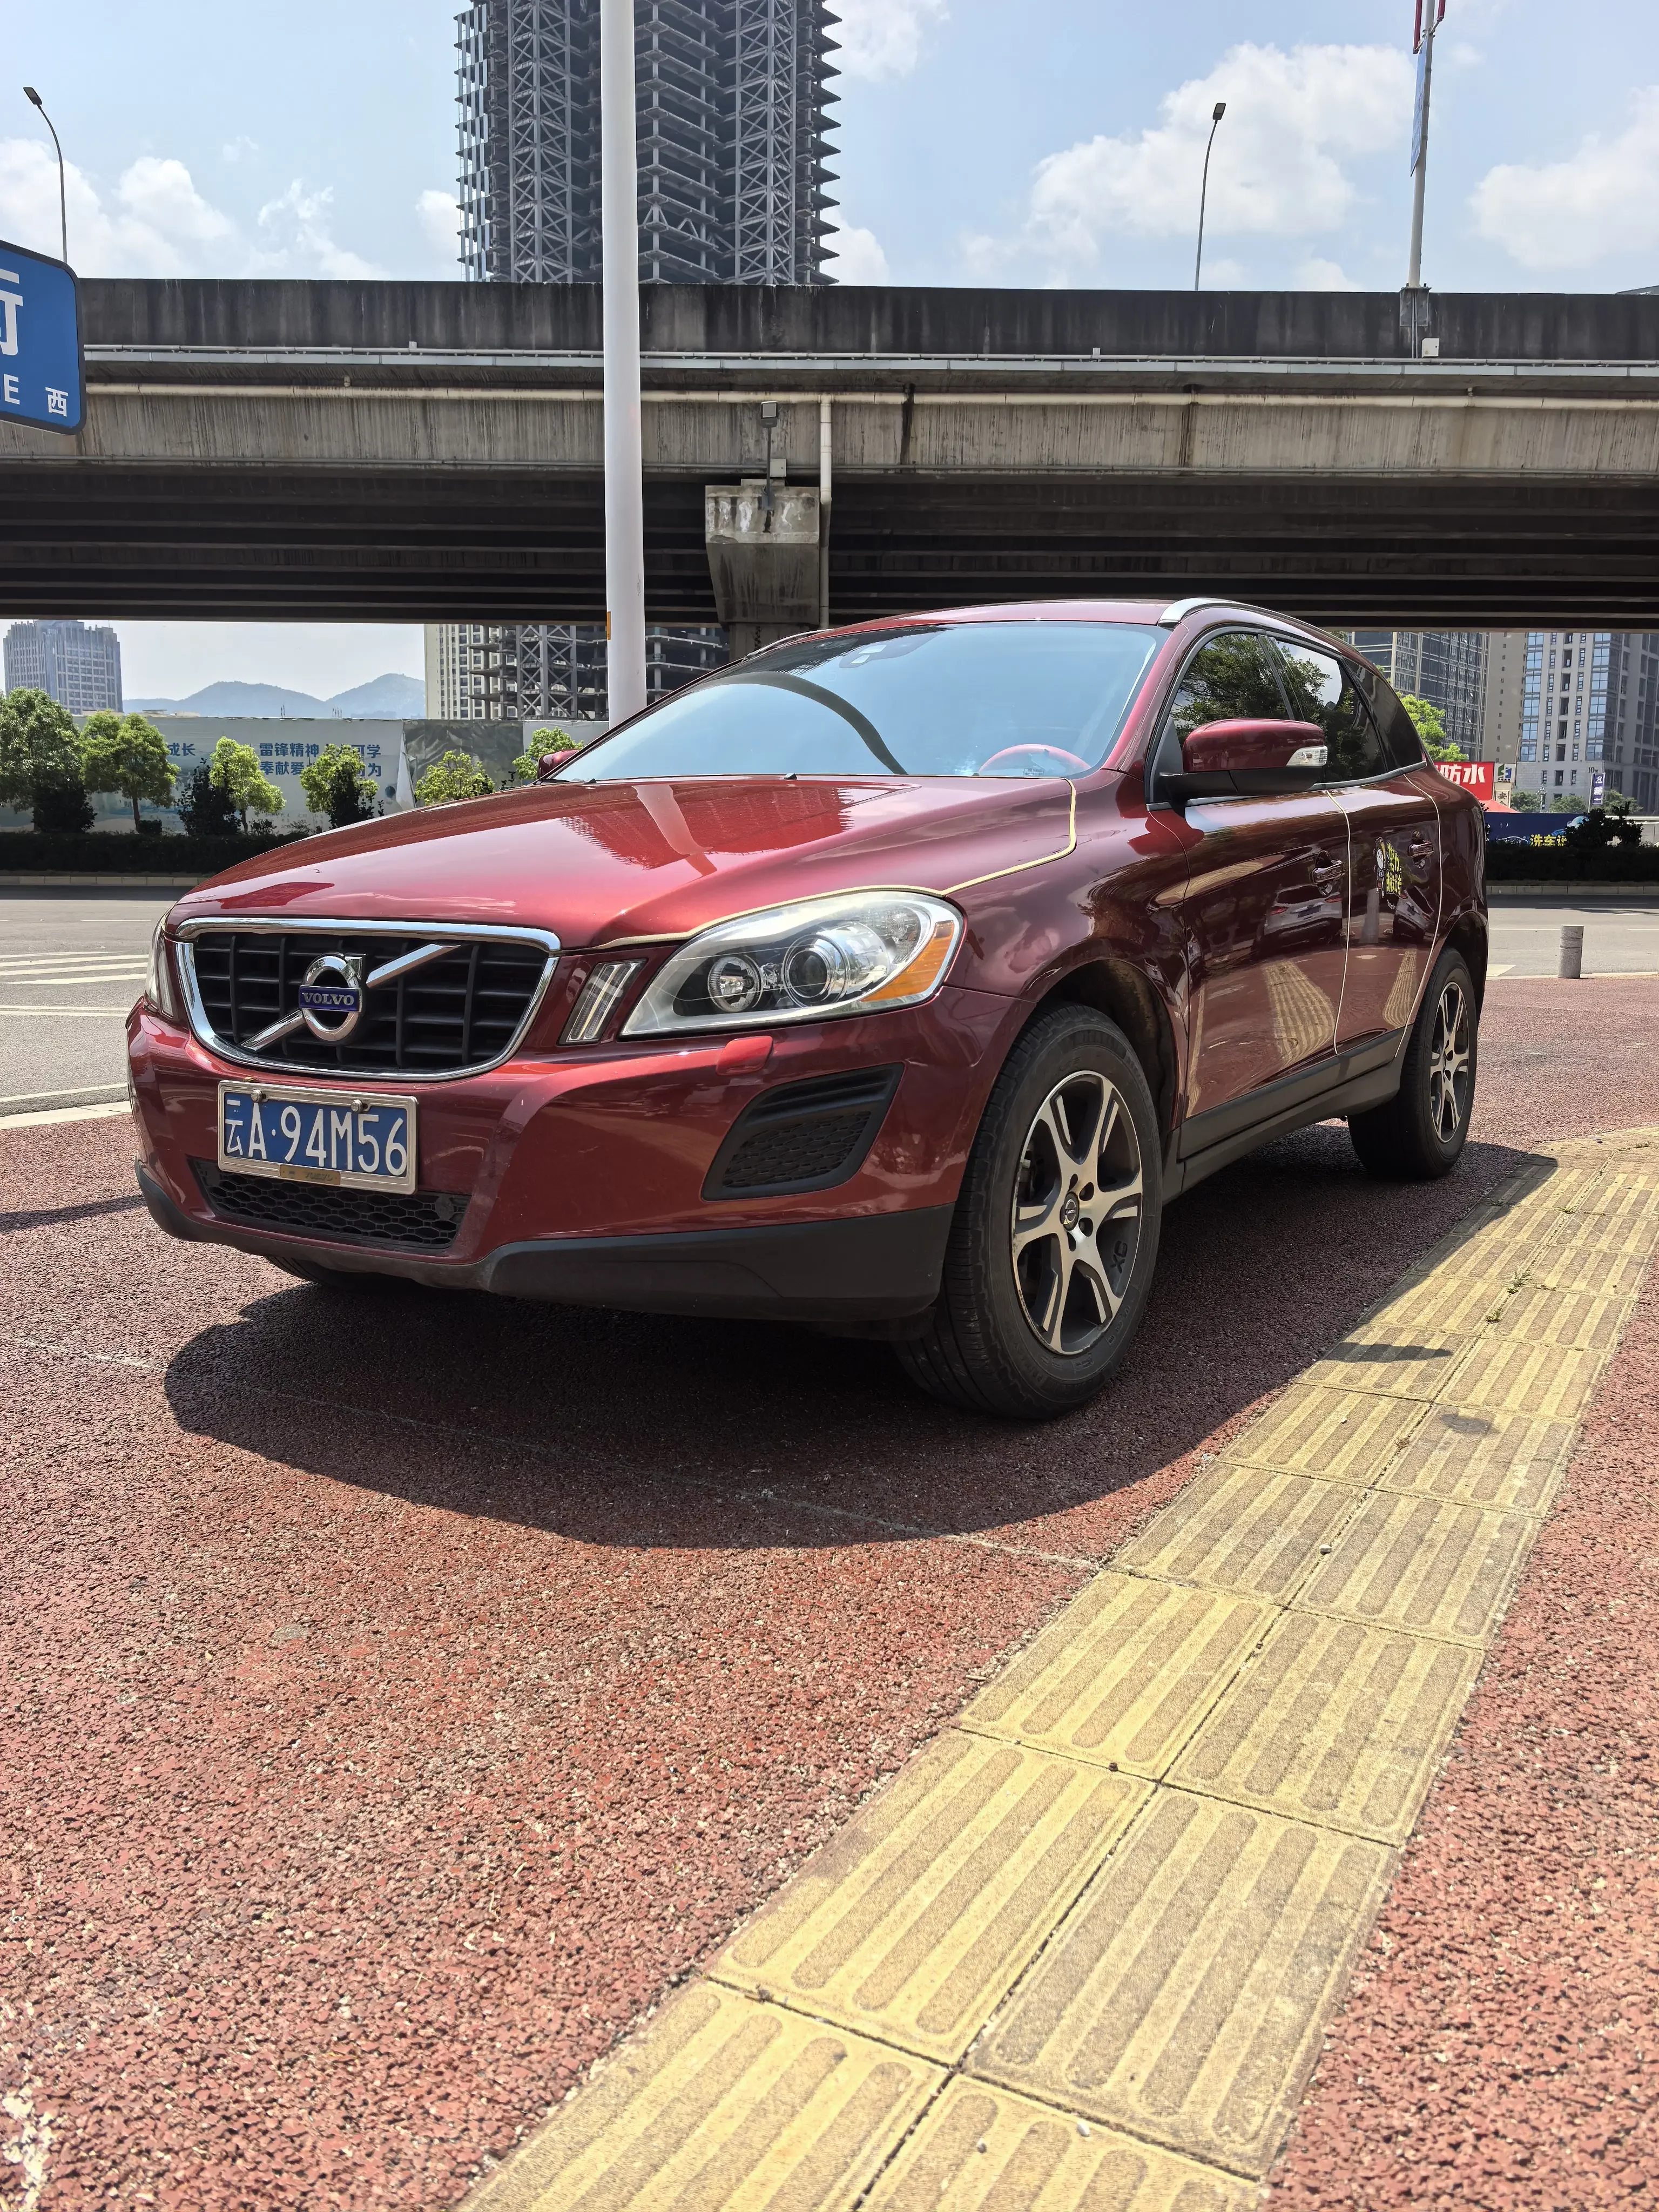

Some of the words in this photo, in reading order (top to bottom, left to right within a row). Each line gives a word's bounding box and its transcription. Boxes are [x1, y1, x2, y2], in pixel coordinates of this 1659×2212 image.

[45, 387, 69, 417] 西
[1436, 764, 1485, 785] 防水
[302, 992, 354, 1006] VOLVO
[225, 1100, 407, 1176] 云A·94M56
